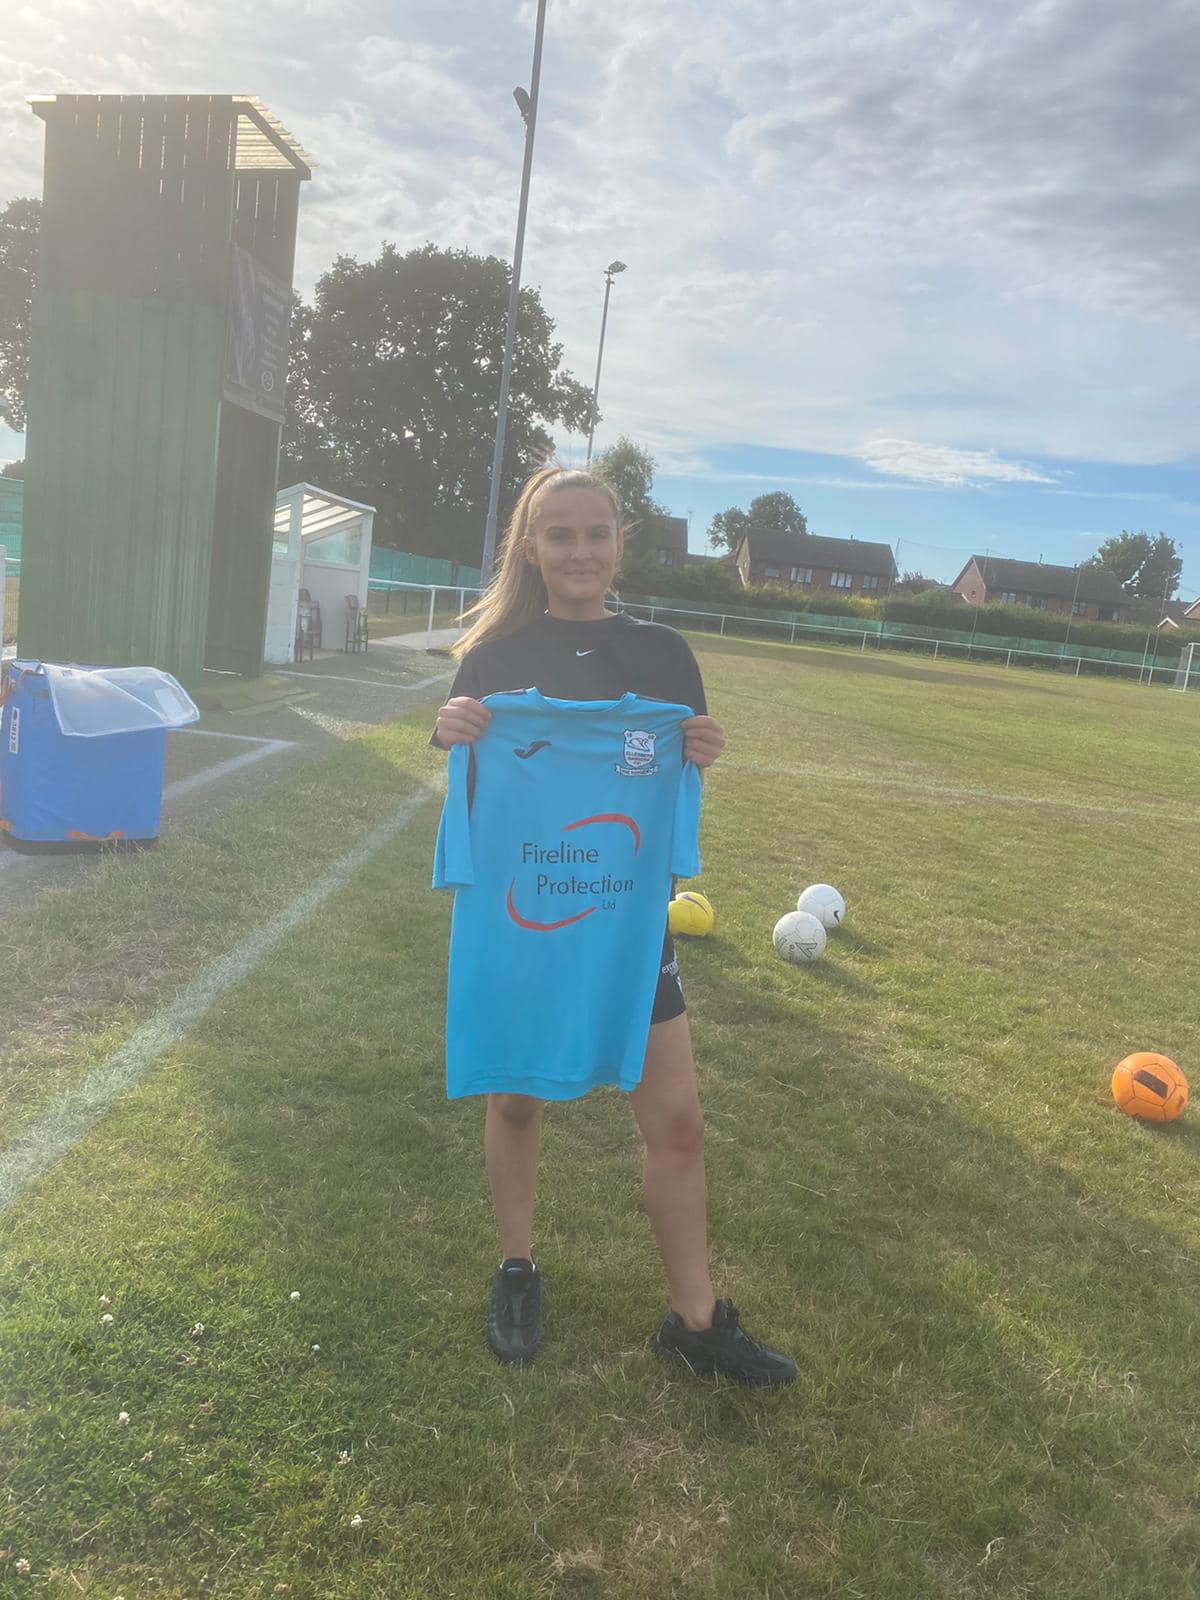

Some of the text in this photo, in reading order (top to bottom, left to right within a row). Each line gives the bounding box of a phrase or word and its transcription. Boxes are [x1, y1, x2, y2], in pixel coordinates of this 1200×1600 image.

[522, 841, 599, 864] Fireline
[537, 874, 633, 895] Protection
[602, 899, 616, 910] Ltd
